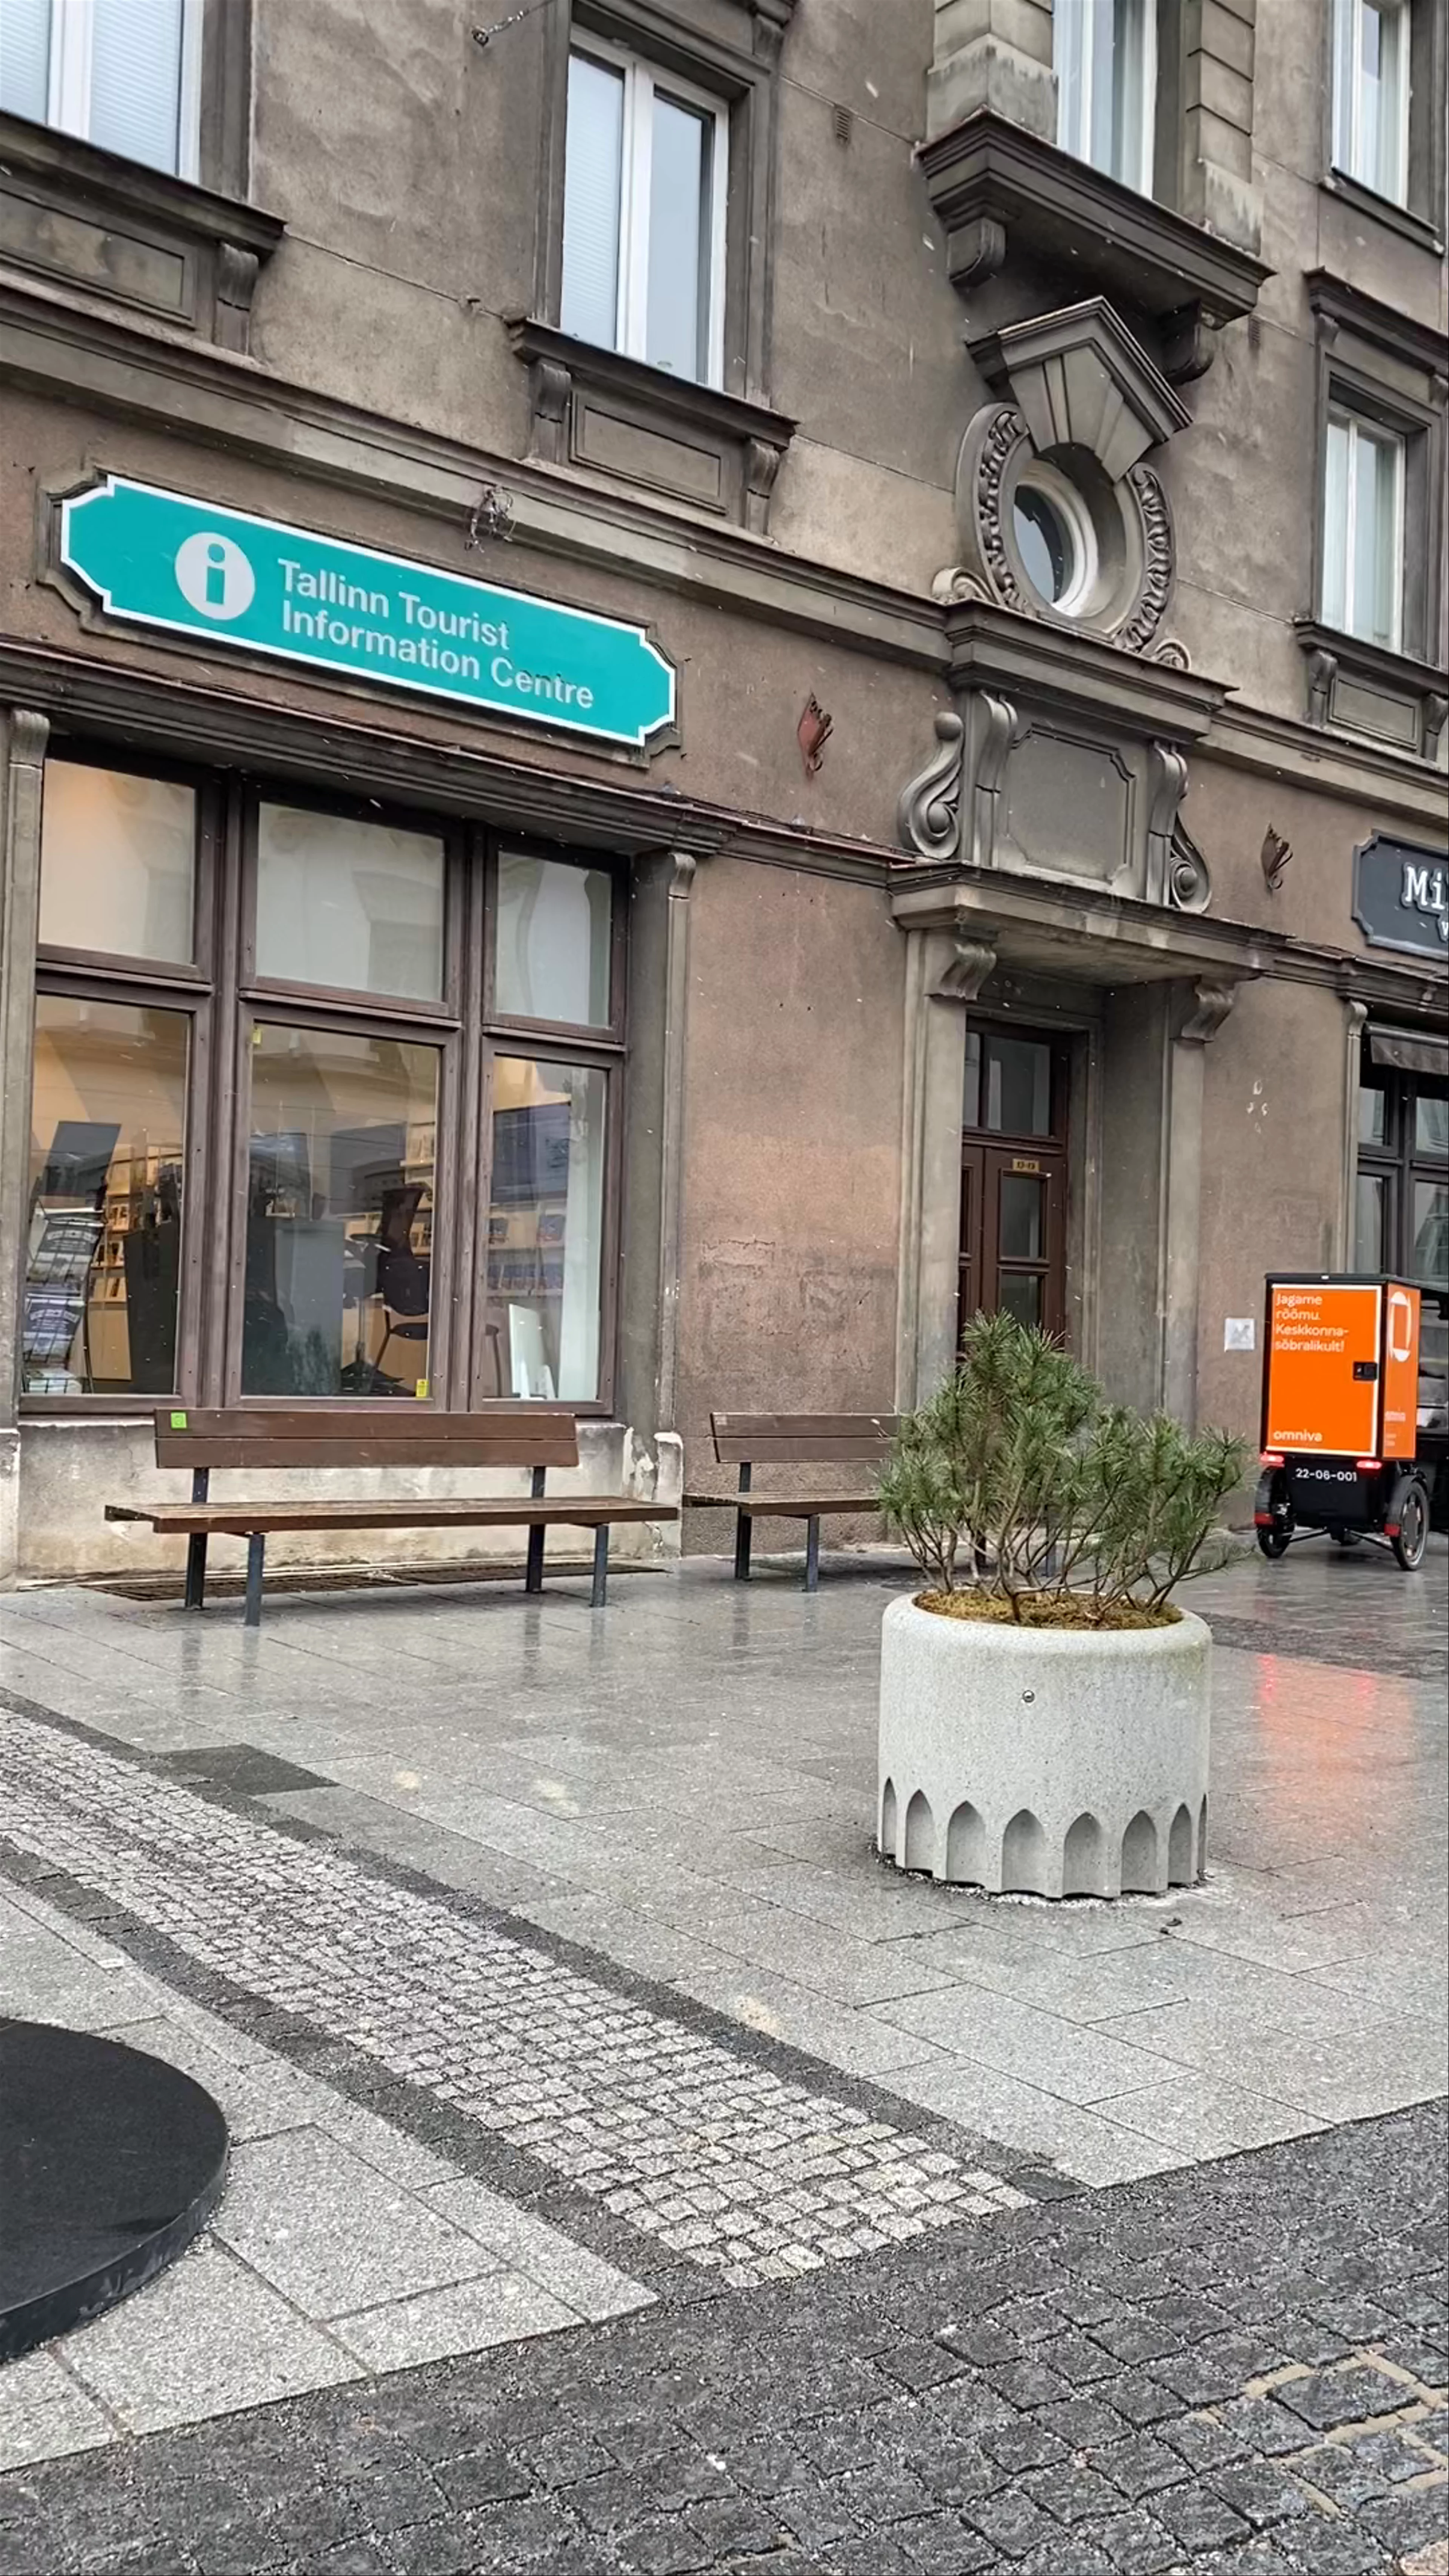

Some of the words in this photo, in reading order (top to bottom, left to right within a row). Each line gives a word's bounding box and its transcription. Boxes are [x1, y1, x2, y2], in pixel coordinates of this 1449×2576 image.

[277, 557, 389, 618] Tallinn
[398, 591, 510, 651] Tourist
[283, 599, 480, 680] Information
[491, 657, 594, 709] Centre
[1276, 1293, 1323, 1307] Jagame
[1276, 1323, 1349, 1336] Keskkonna-
[1273, 1428, 1323, 1442] omniva
